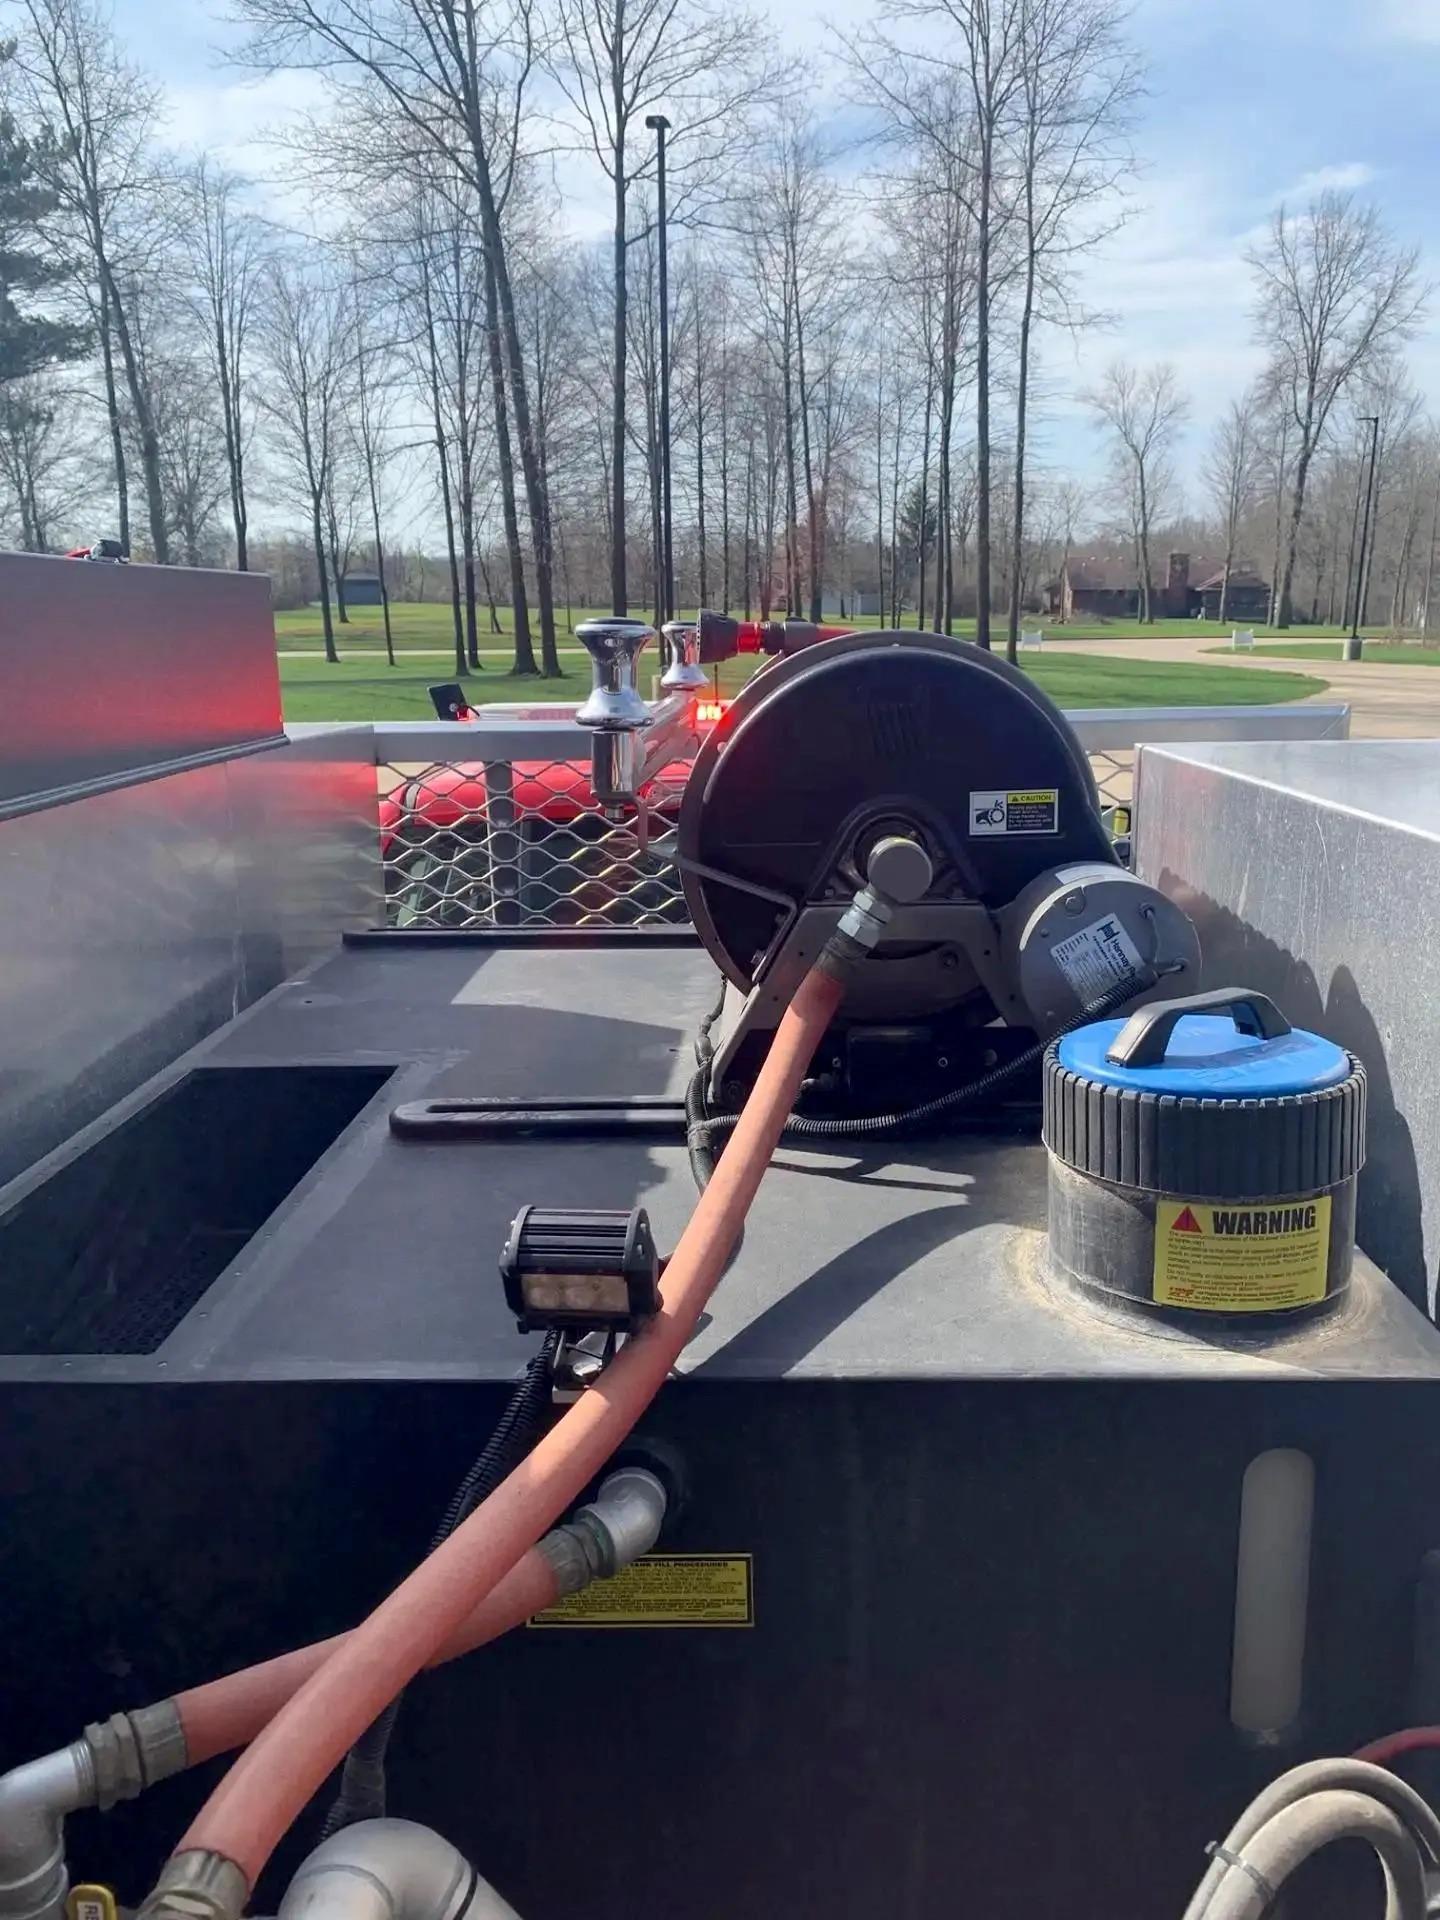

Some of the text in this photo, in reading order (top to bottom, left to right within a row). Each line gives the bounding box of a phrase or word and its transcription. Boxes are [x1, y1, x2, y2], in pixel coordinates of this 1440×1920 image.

[1020, 794, 1052, 802] CAUTION
[1111, 939, 1130, 968] Hannay
[1212, 1205, 1316, 1236] WARNING
